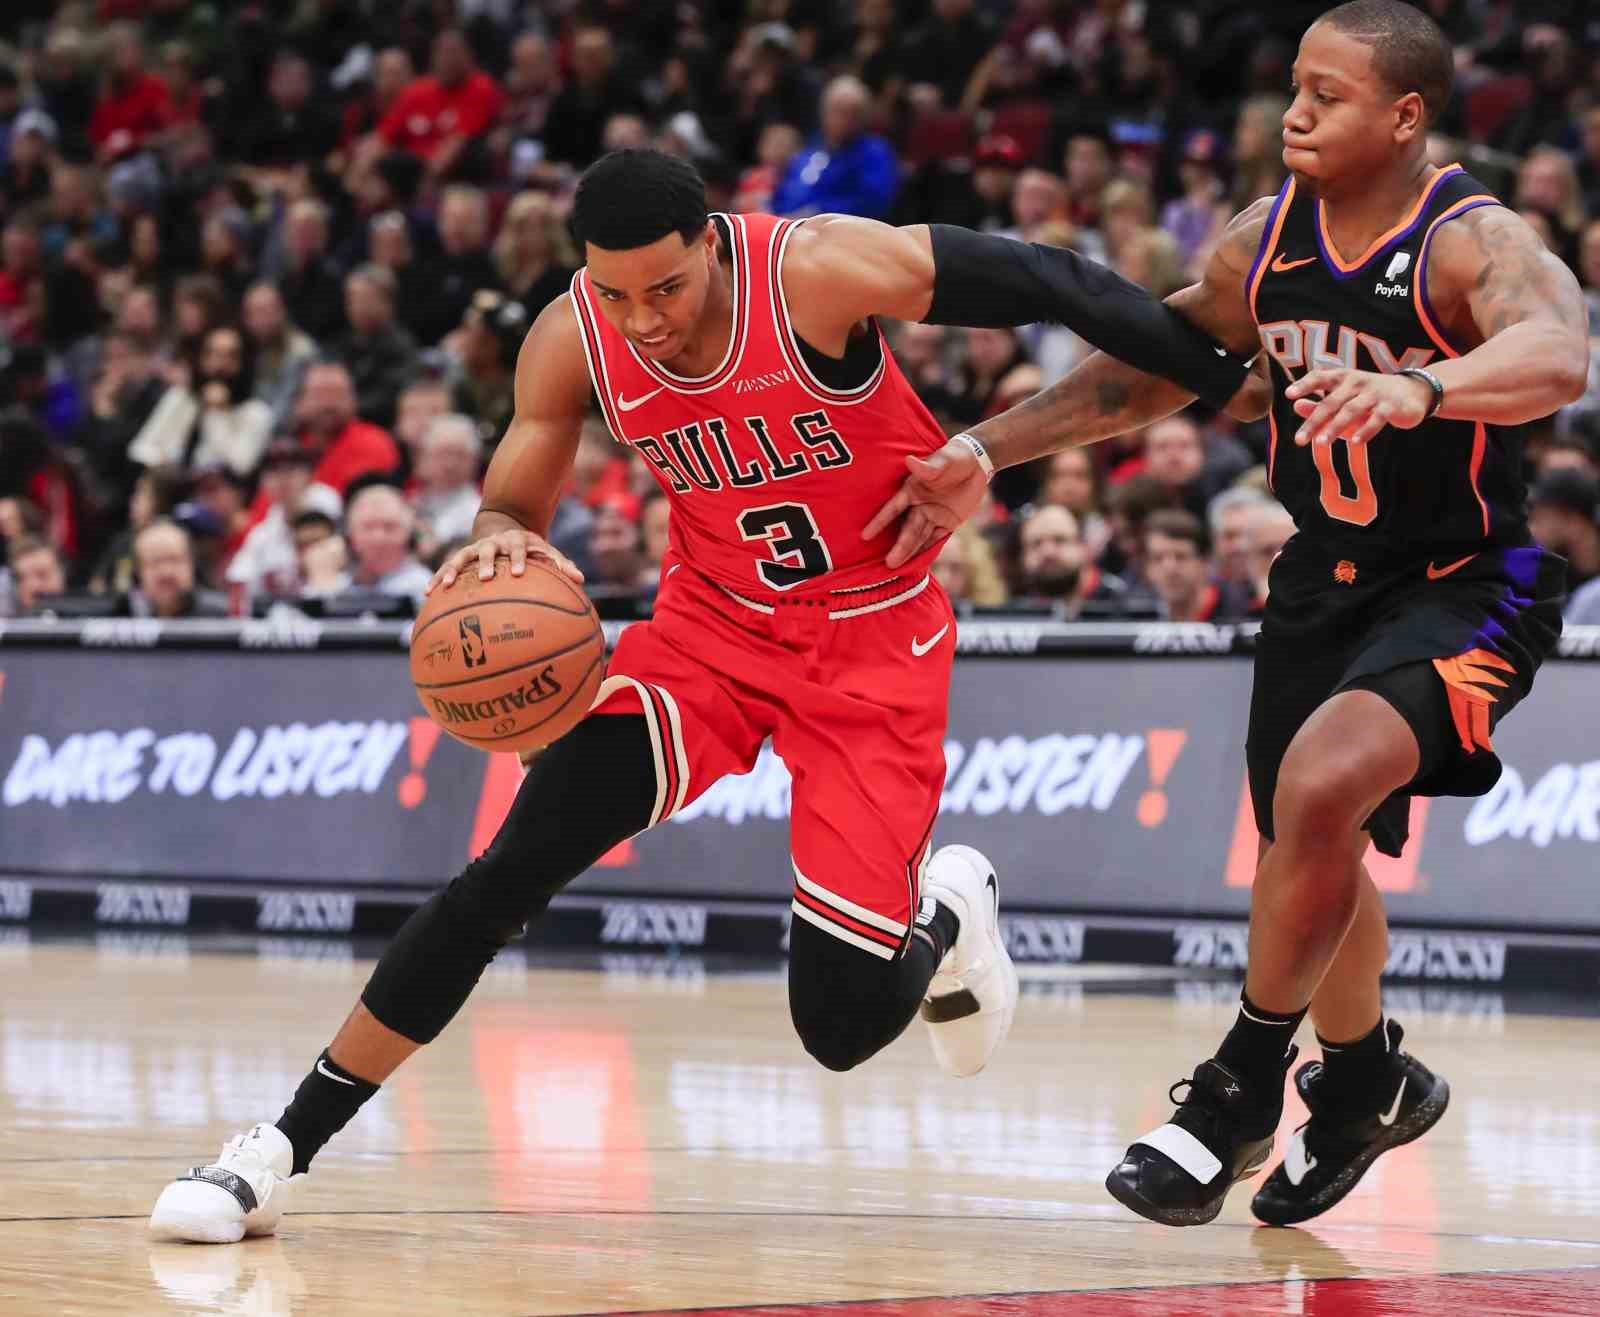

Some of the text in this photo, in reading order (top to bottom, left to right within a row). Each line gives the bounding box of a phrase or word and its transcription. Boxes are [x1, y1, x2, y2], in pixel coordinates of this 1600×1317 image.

[1375, 282, 1409, 298] PayPal
[631, 409, 853, 494] BULLS
[735, 501, 834, 592] 3
[431, 664, 563, 724] SPALDING
[3, 727, 157, 807] DARE
[148, 731, 217, 796] TO
